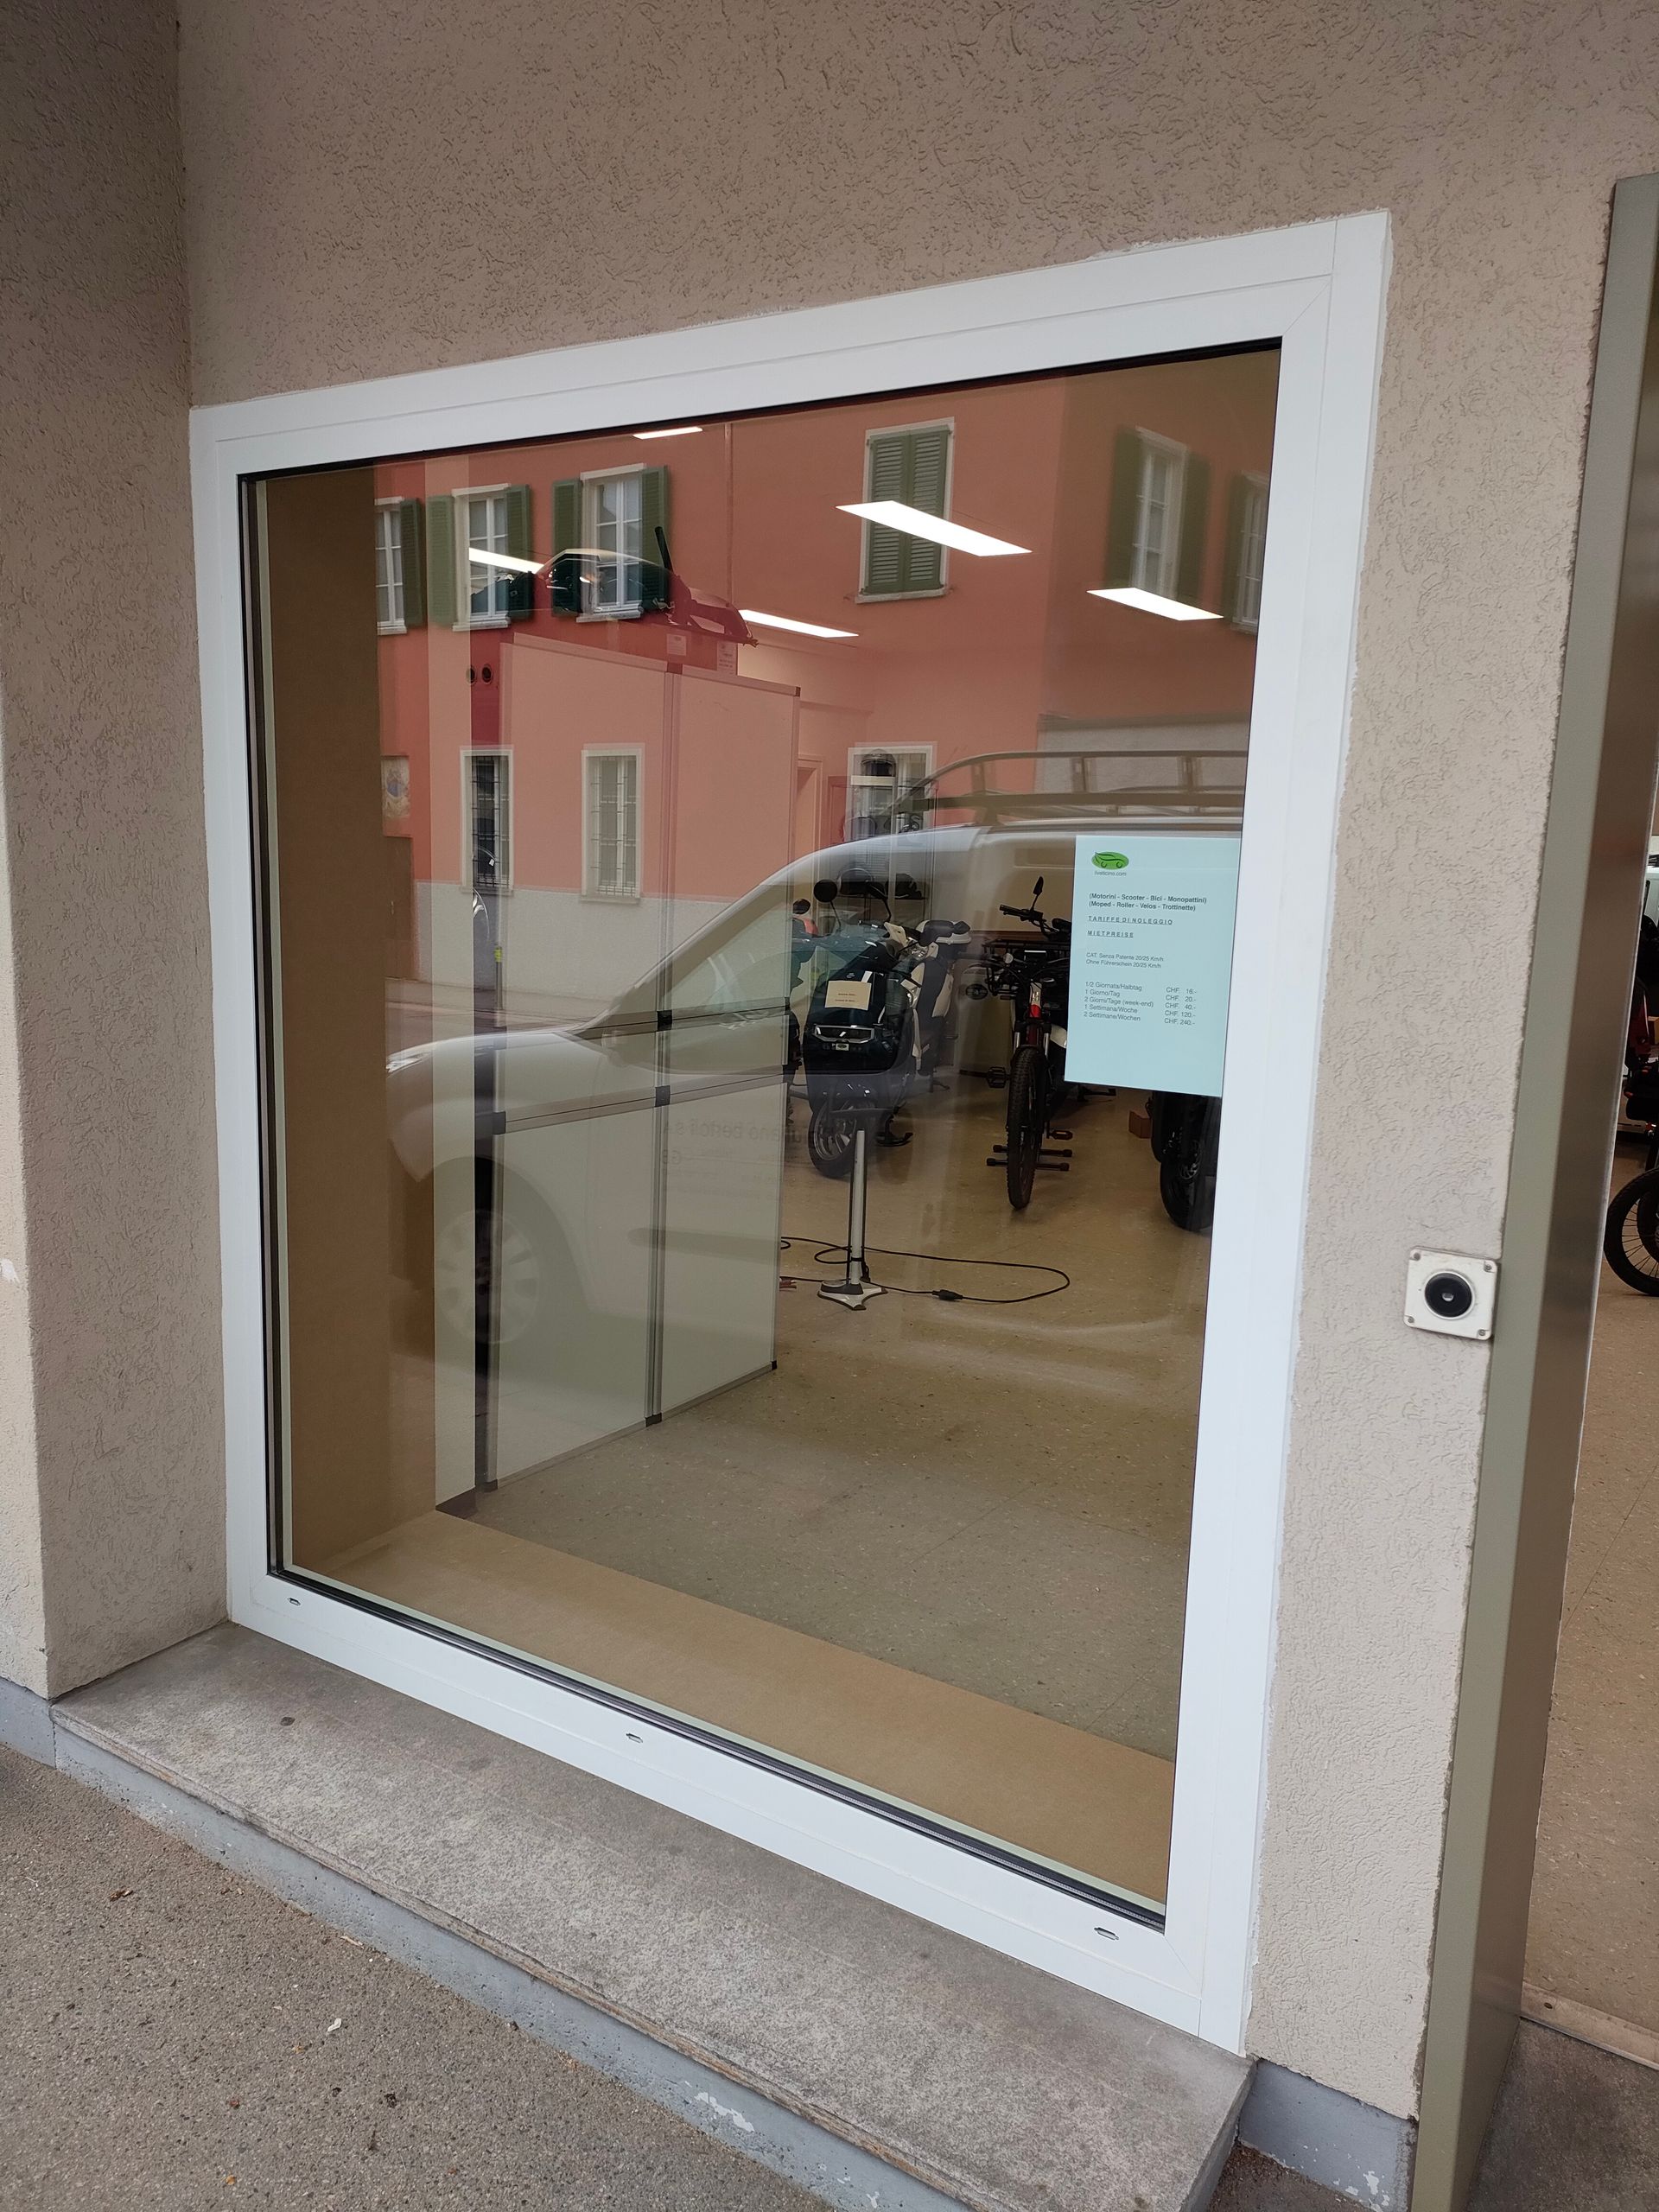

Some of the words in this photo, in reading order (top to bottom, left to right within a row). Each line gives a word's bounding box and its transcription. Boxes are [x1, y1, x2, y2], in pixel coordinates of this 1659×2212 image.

[1167, 896, 1207, 905] Monopattini)
[1162, 903, 1196, 912] Trottinette)
[1087, 930, 1134, 938] MIETPREISE
[1095, 982, 1142, 992] Giornata/Halbtag
[1089, 1004, 1138, 1014] Settimana/Woche
